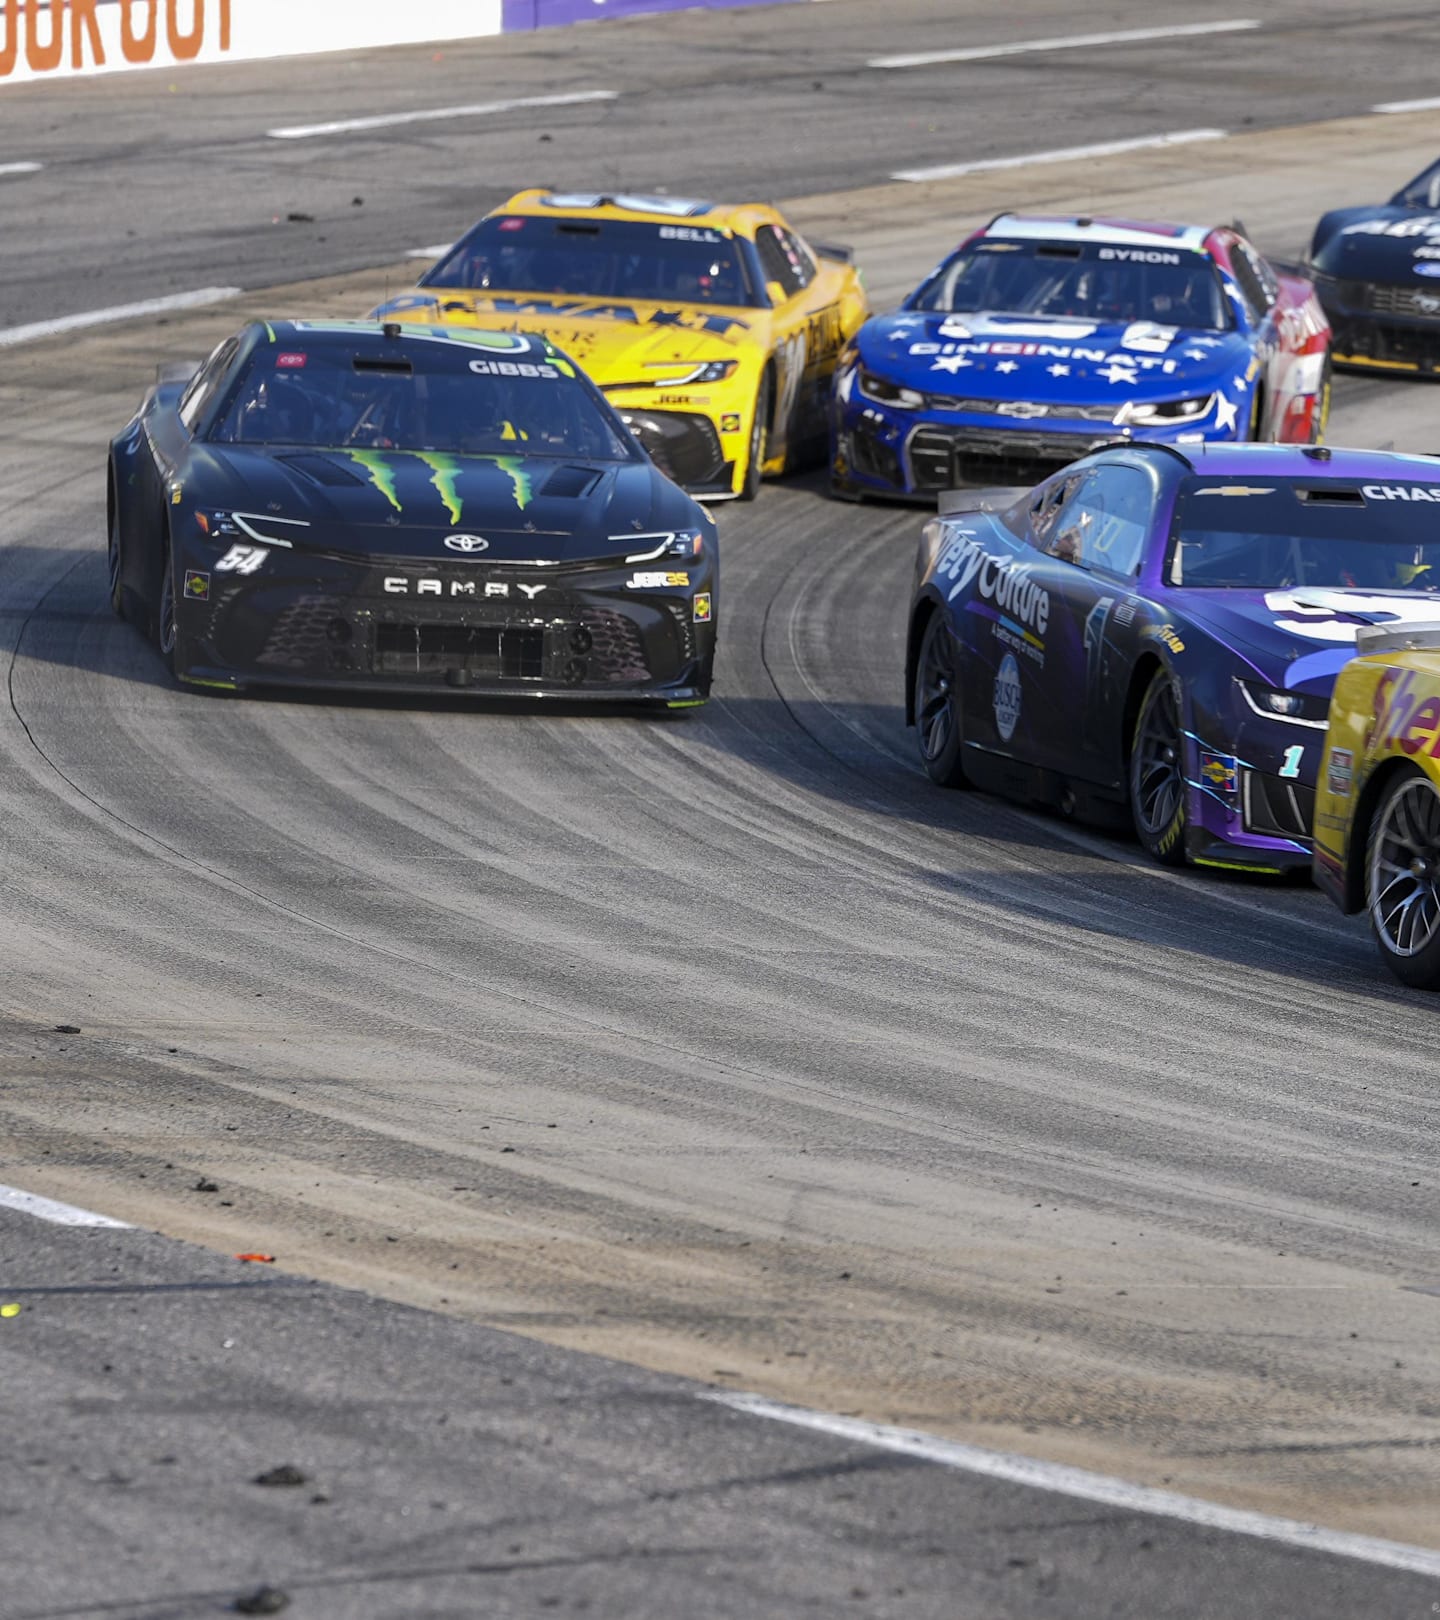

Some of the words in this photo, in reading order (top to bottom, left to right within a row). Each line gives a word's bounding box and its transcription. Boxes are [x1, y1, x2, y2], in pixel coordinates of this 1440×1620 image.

[659, 226, 721, 243] BELL
[1098, 248, 1180, 265] BYRON
[908, 340, 1178, 374] CINCINNATI
[468, 360, 560, 379] GIBBS
[214, 543, 271, 576] 54
[383, 576, 548, 600] CAMRY
[1278, 744, 1305, 778] 1
